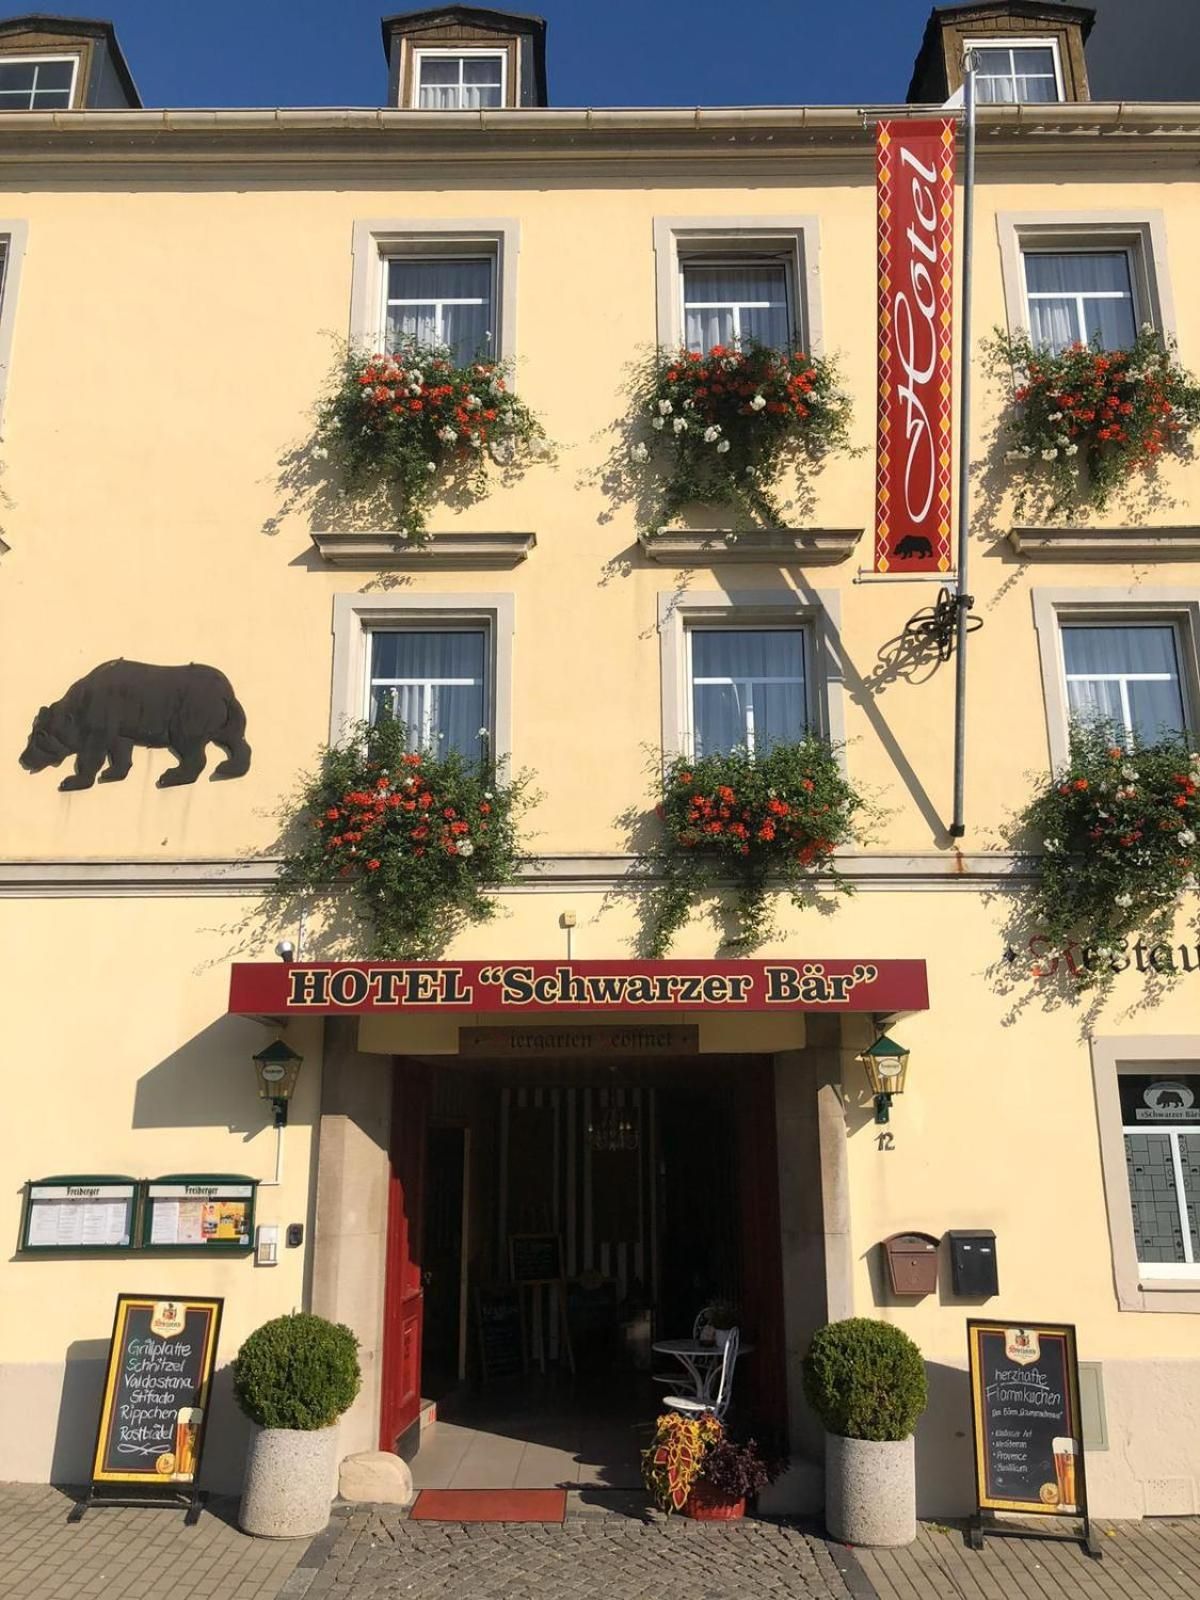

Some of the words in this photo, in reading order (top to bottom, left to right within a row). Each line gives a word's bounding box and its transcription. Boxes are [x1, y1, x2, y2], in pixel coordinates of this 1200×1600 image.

[894, 146, 938, 523] Hotel
[287, 967, 473, 1006] HOTEL
[874, 1131, 896, 1151] 12
[66, 1185, 100, 1198] Freiberger
[184, 1184, 219, 1197] Freiberger
[127, 1338, 192, 1362] Grillplatte
[126, 1357, 186, 1372] Schnitzel
[124, 1373, 194, 1389] Valdostana
[995, 1367, 1048, 1386] herzhafte
[129, 1388, 175, 1404] Stifado
[986, 1384, 1061, 1405] Flammkuchen
[119, 1404, 178, 1425] Rippchen
[996, 1451, 1028, 1460] Provence
